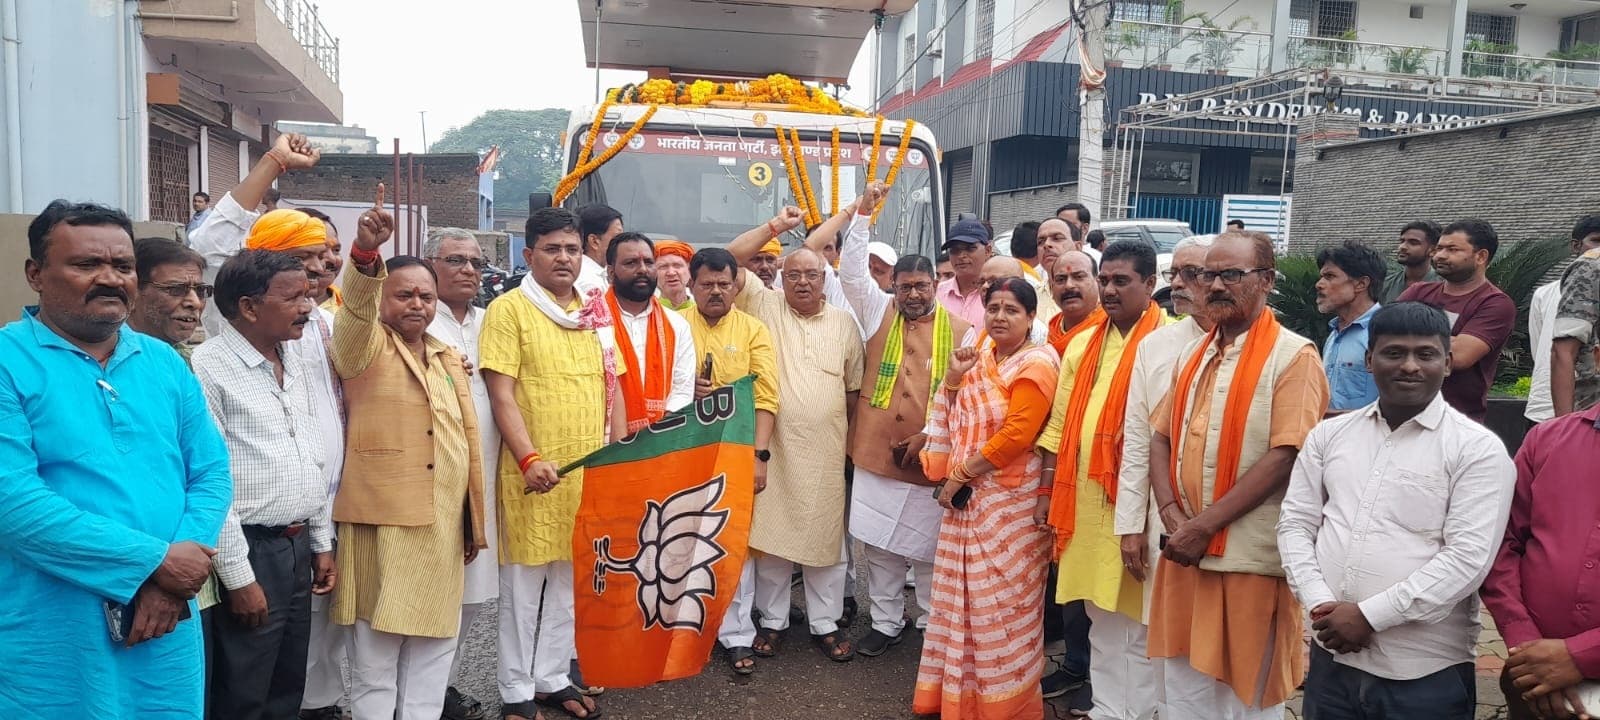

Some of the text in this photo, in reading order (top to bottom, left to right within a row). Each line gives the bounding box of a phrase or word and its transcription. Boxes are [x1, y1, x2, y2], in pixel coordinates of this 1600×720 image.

[1196, 98, 1381, 126] RESIDEN
[1366, 108, 1383, 130] &
[657, 136, 700, 150] भारतीय
[703, 139, 736, 153] जनता
[754, 166, 765, 181] 3
